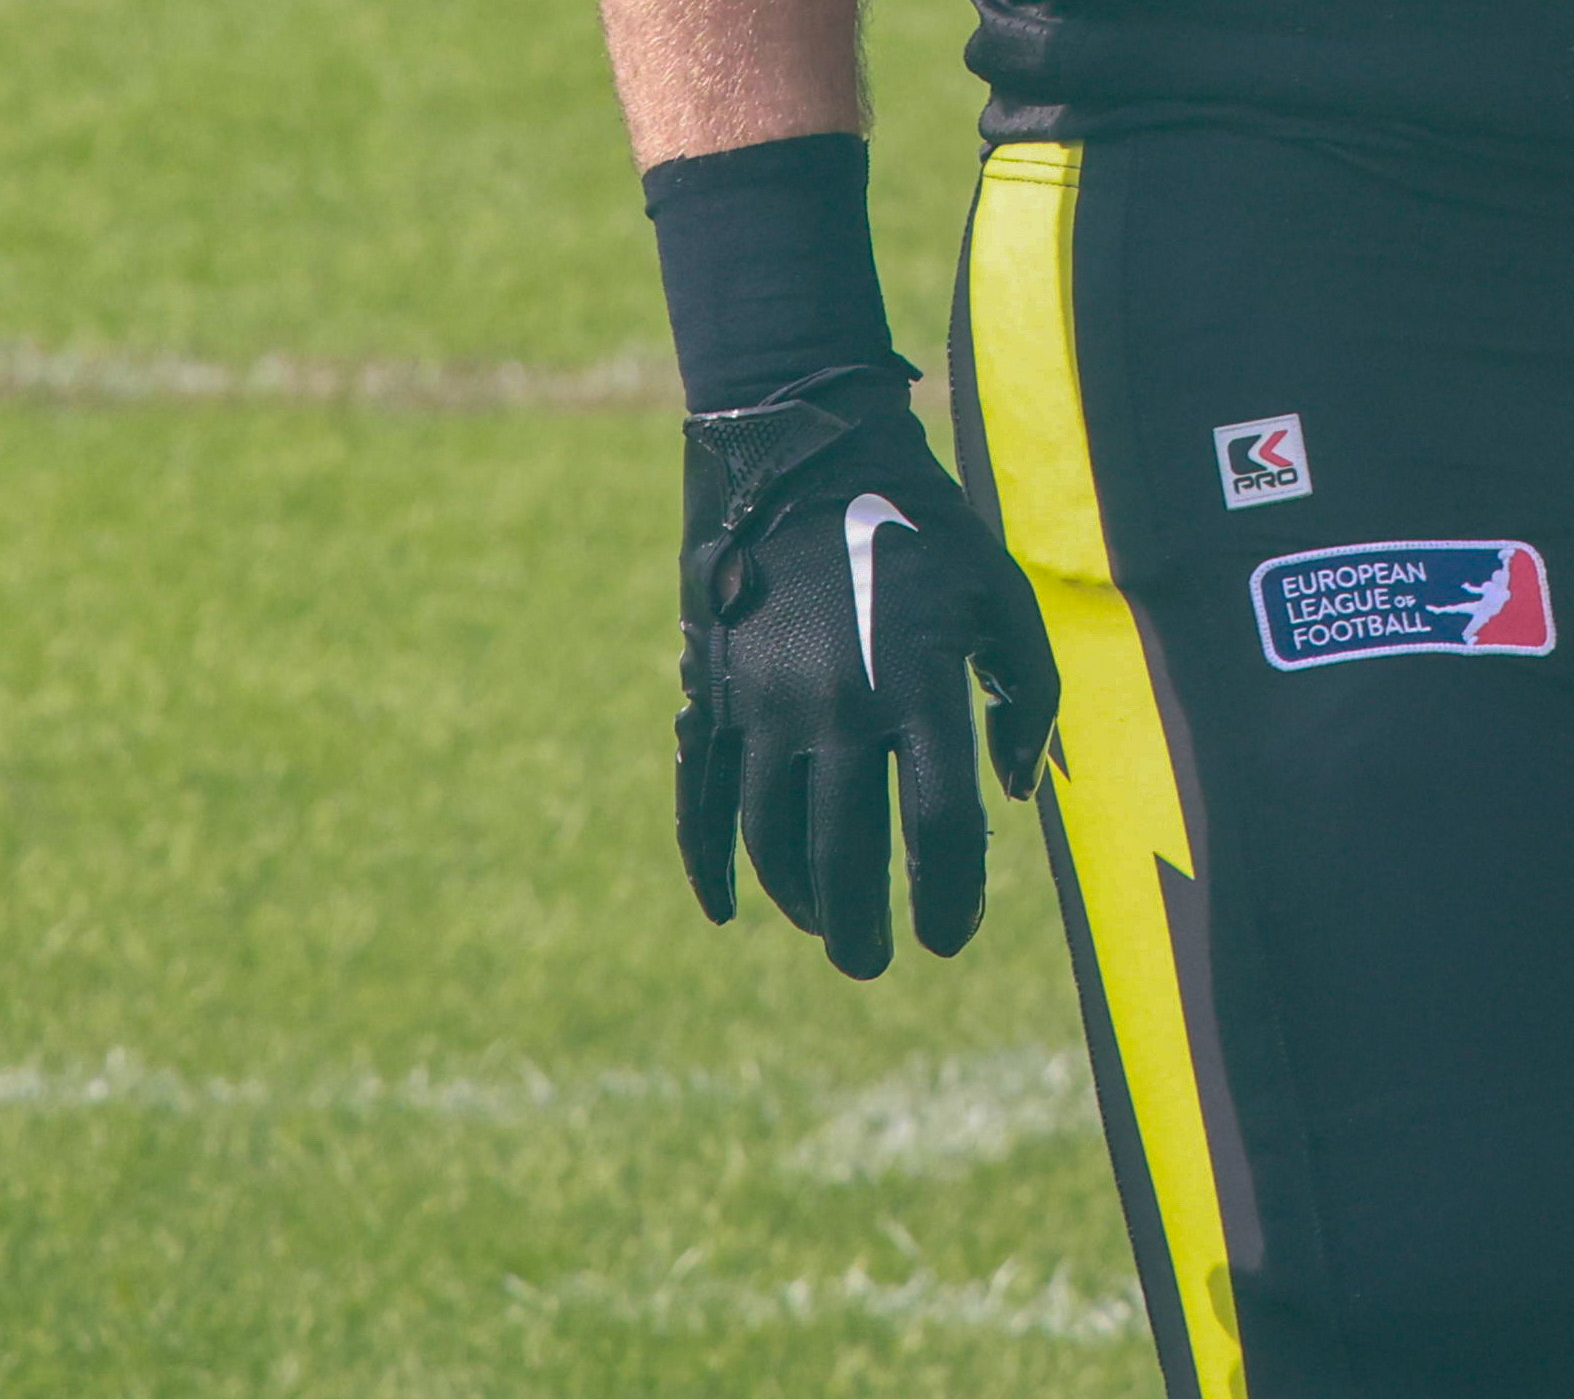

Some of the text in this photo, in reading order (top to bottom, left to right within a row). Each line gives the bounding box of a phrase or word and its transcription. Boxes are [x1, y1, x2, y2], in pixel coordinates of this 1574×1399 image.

[1232, 466, 1299, 495] PRO
[1281, 561, 1428, 599] EUROPEAN
[1286, 588, 1418, 624] LEAGUE OF
[1293, 611, 1432, 651] FOOTBALL
